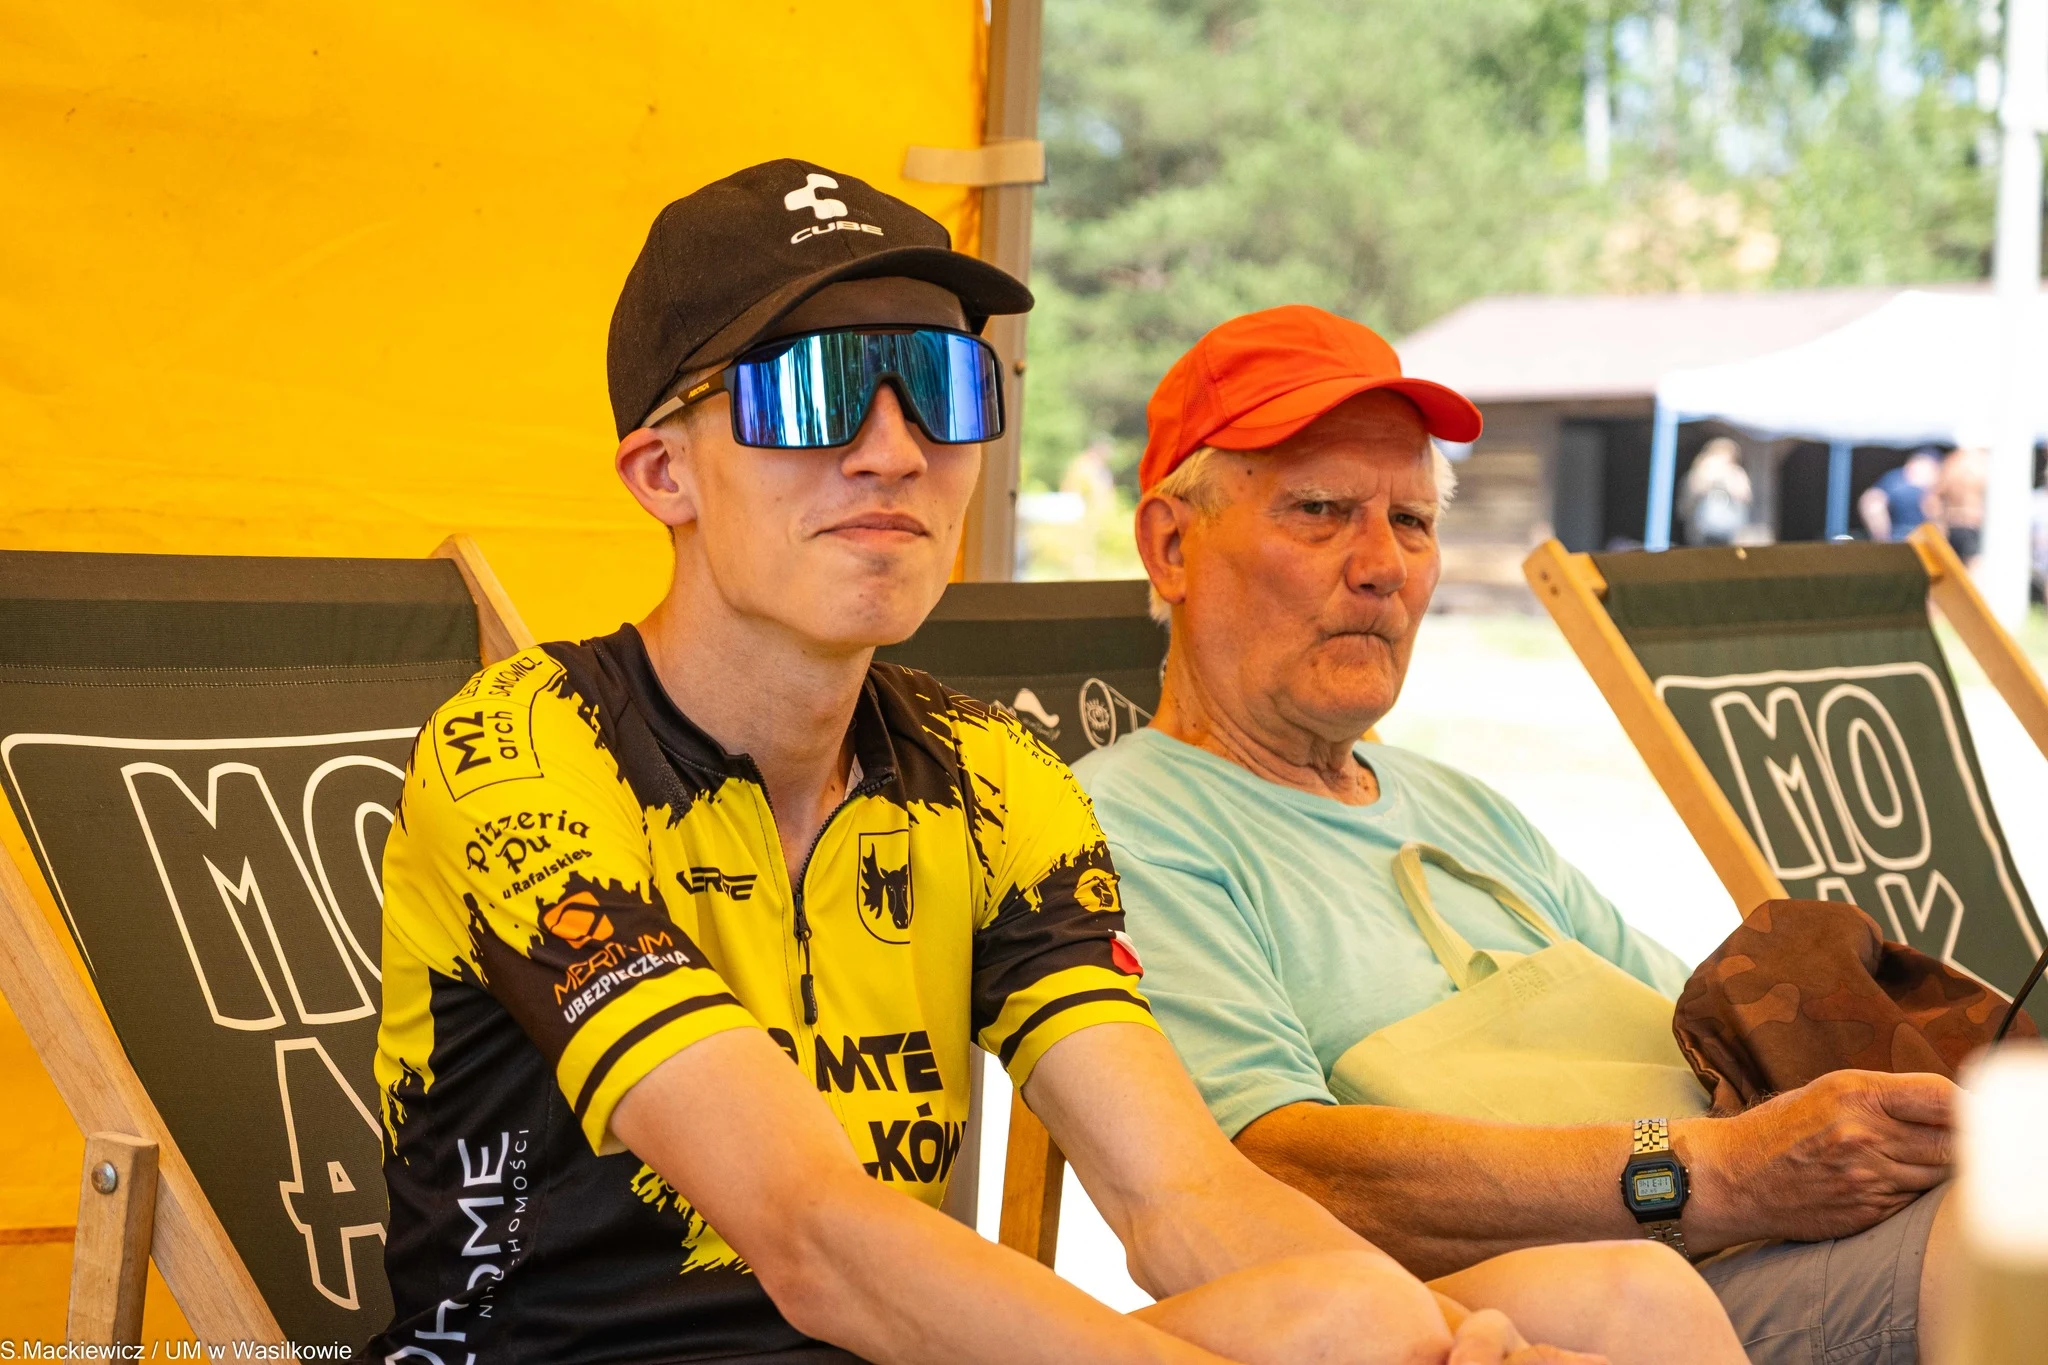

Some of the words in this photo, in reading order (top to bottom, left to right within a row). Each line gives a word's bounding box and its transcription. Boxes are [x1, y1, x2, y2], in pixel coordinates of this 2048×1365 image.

[790, 221, 884, 244] CUBE
[443, 711, 492, 776] M2
[486, 711, 519, 760] arch
[1711, 683, 1932, 880] MO
[466, 810, 591, 874] Pizzeria
